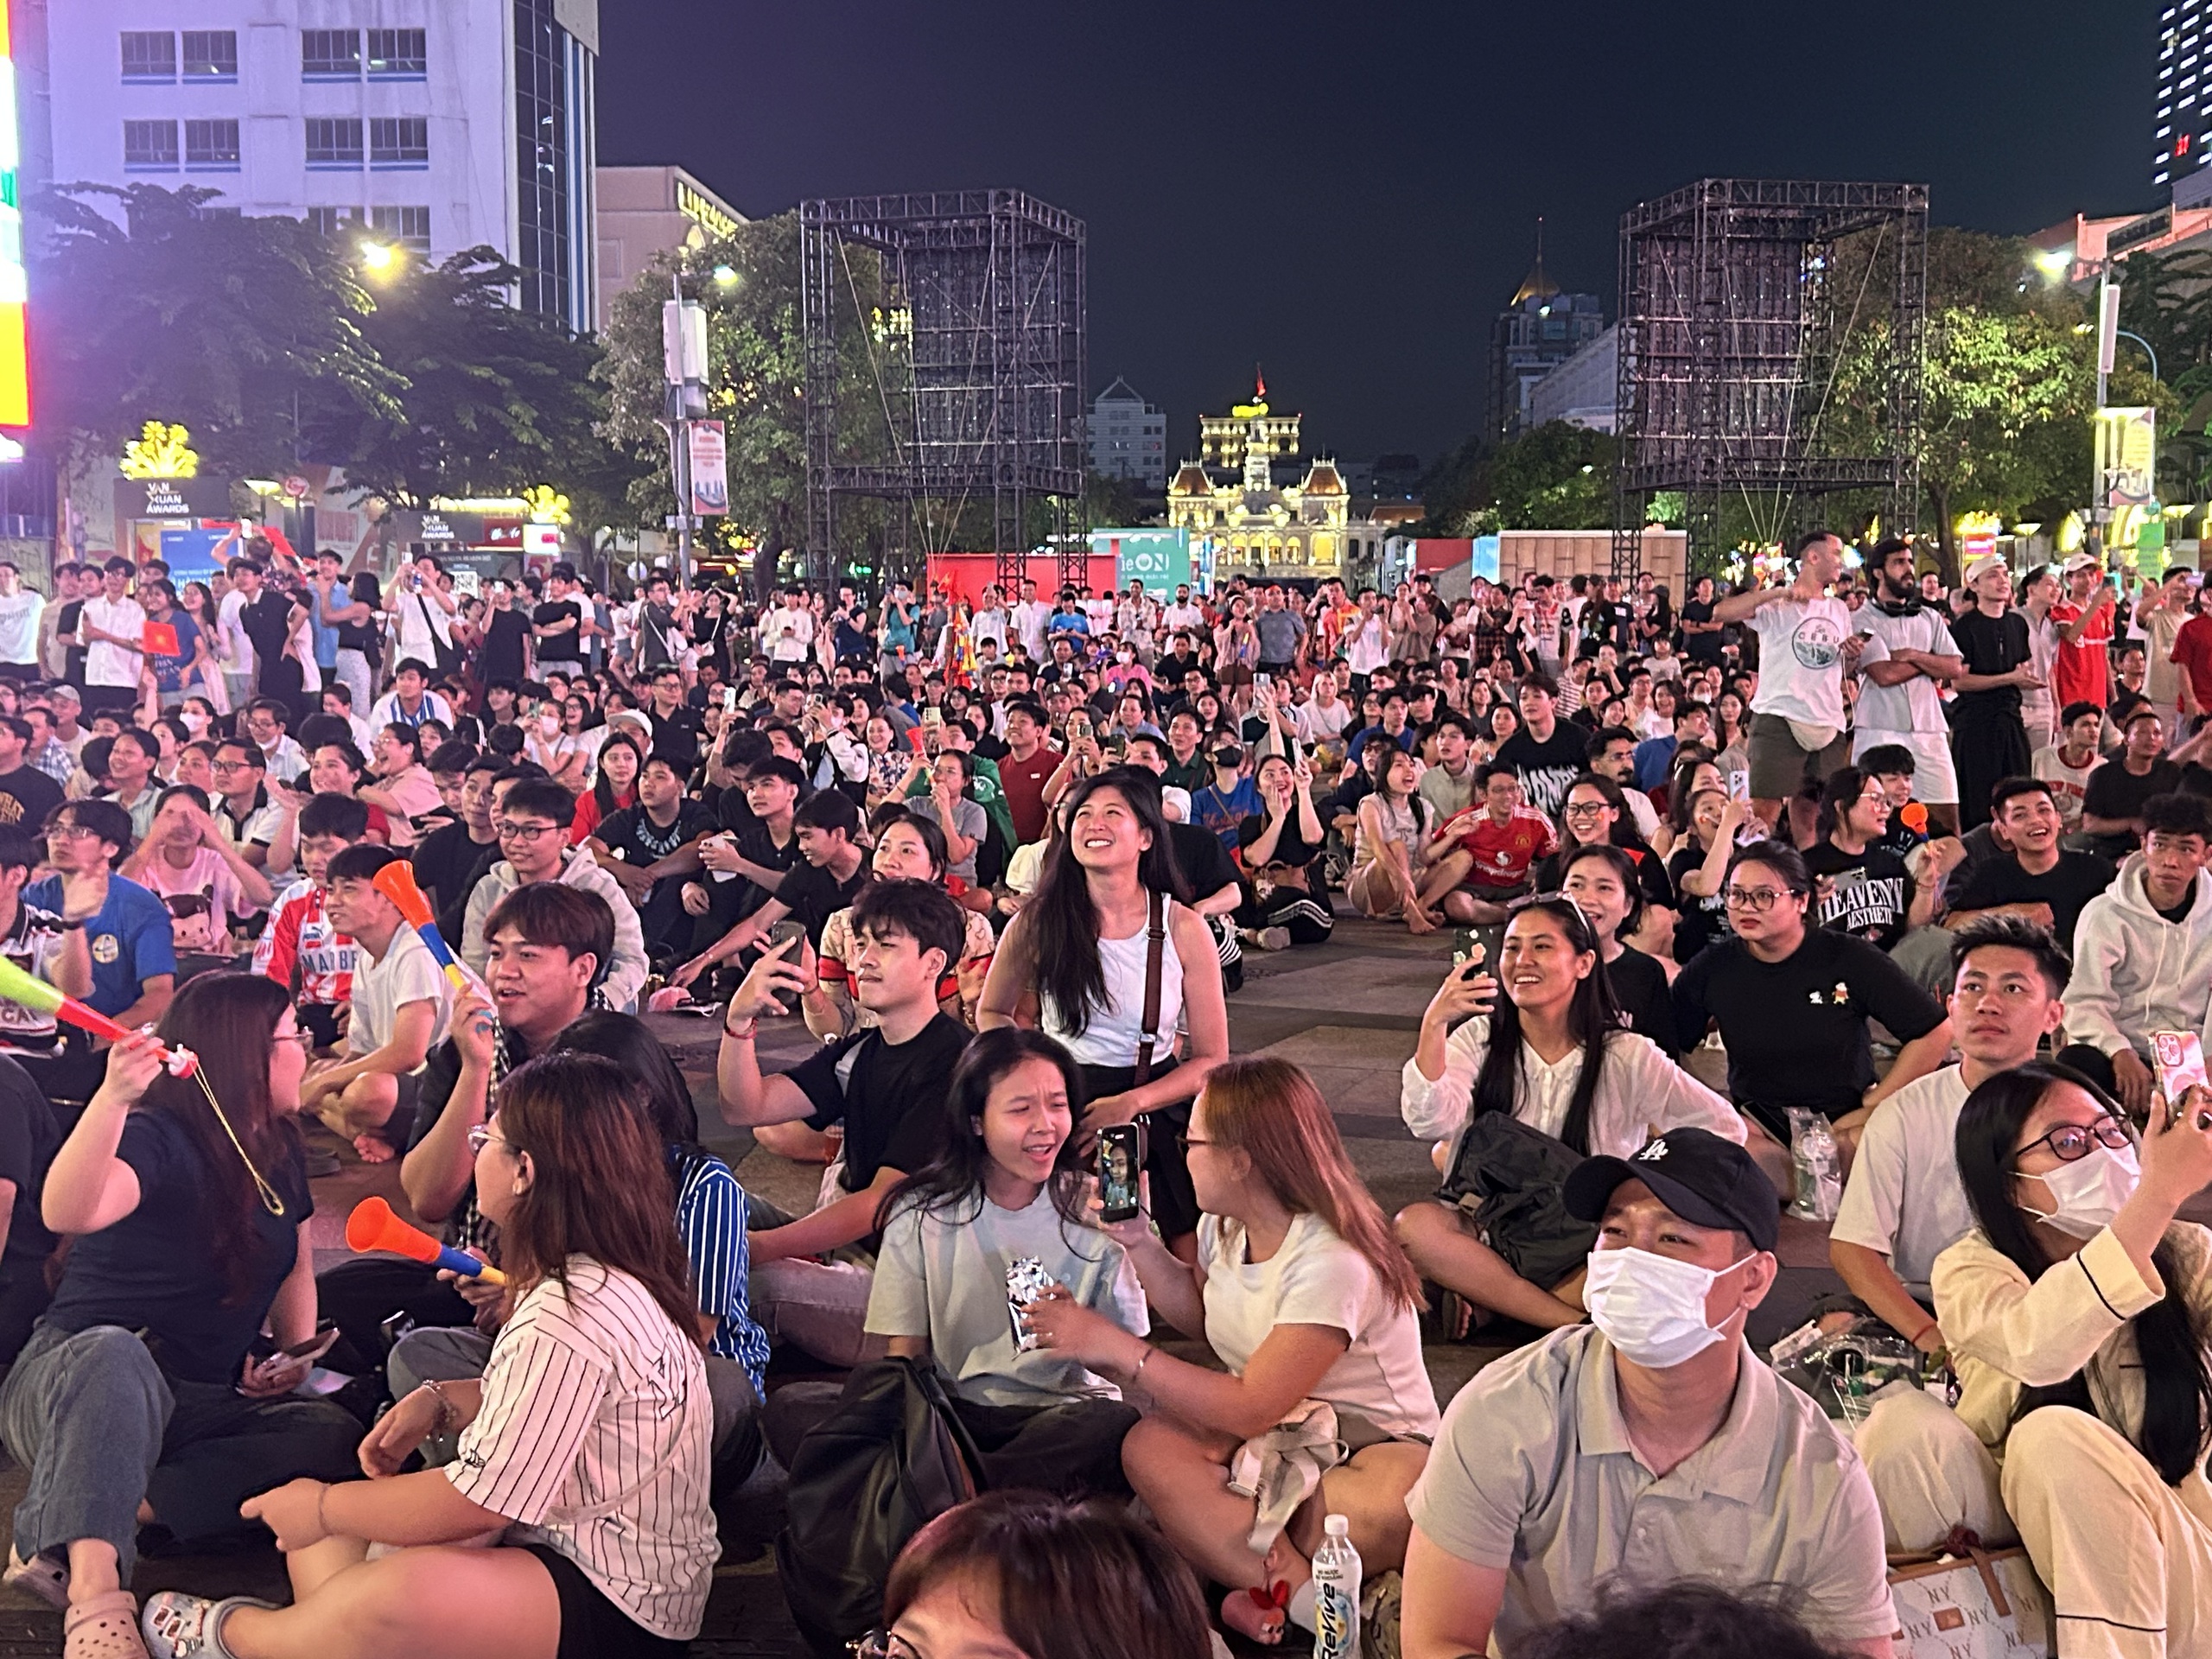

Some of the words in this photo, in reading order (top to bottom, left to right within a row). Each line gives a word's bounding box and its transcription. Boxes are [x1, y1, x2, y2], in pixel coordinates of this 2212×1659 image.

[1798, 632, 1840, 644] CEBU
[1638, 1138, 1669, 1160] LA
[1927, 1585, 1950, 1605] NY
[1907, 1620, 1932, 1640] NY
